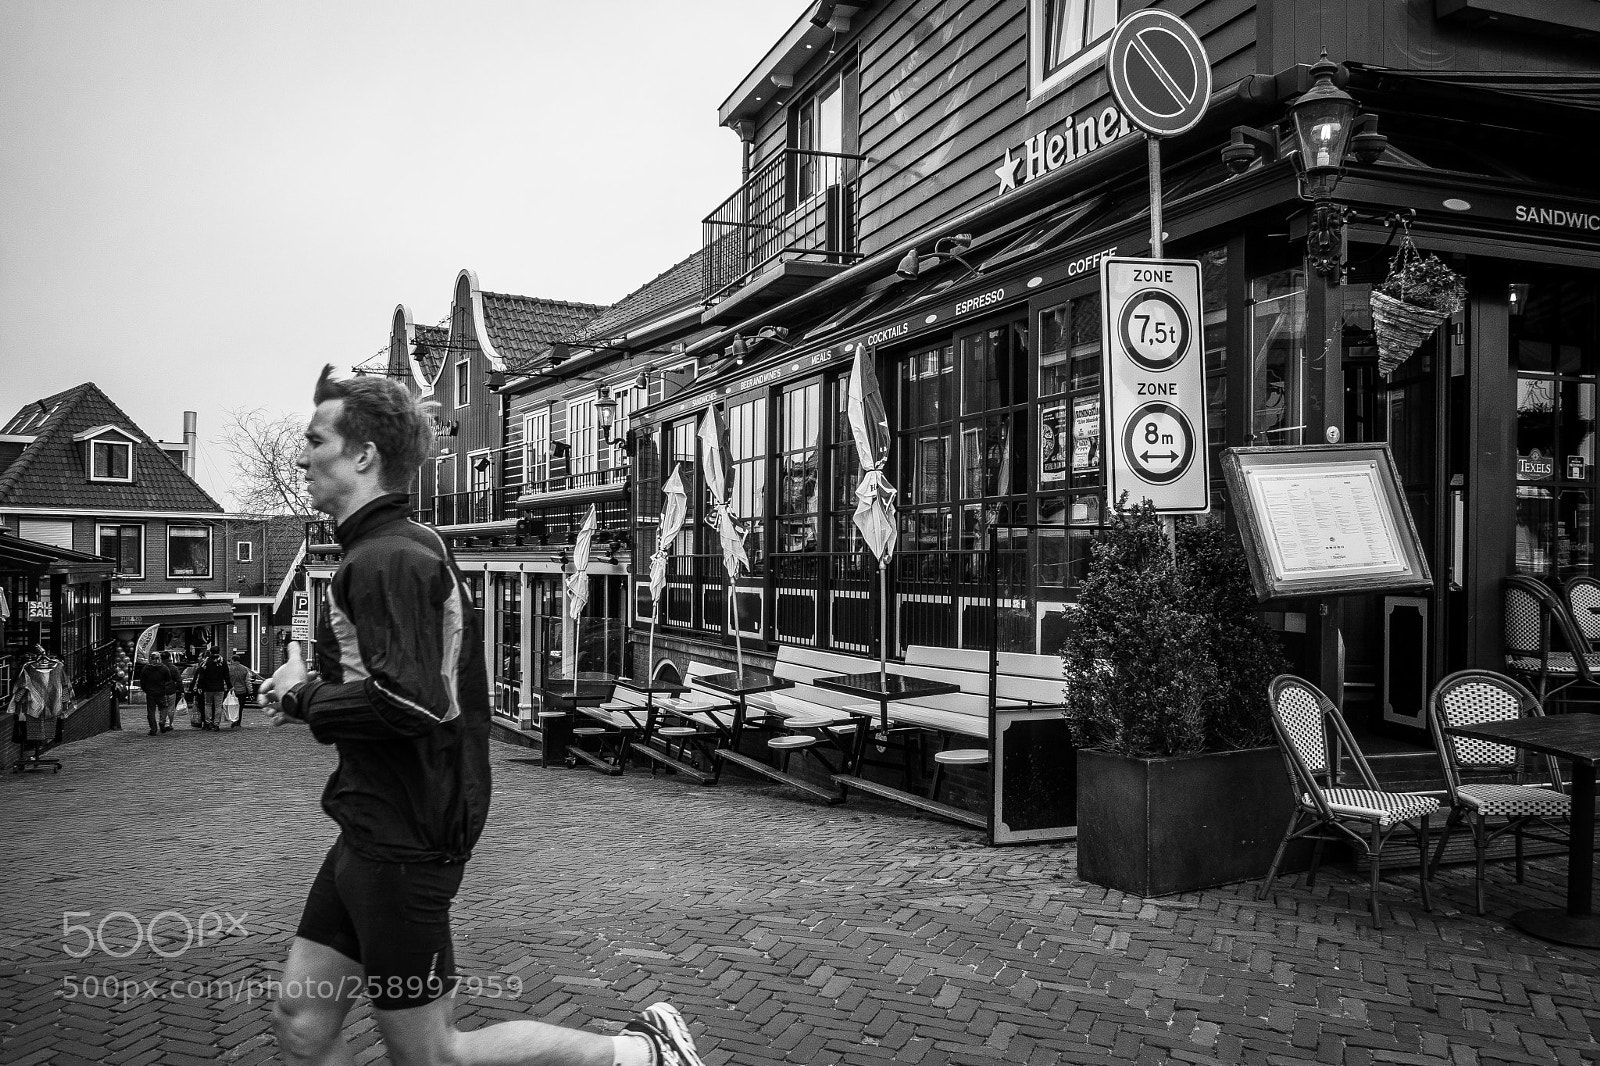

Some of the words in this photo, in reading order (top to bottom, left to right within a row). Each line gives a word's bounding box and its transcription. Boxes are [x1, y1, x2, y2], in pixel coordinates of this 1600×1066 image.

[1133, 269, 1174, 283] ZONE
[955, 288, 1005, 316] ESPRESSO
[867, 322, 909, 346] COCKTAILS
[811, 350, 832, 365] MEALS
[1137, 382, 1178, 396] ZONE
[1518, 459, 1551, 474] TEXELS
[30, 601, 53, 609] SALE
[298, 598, 308, 609] P
[30, 609, 53, 618] SALE
